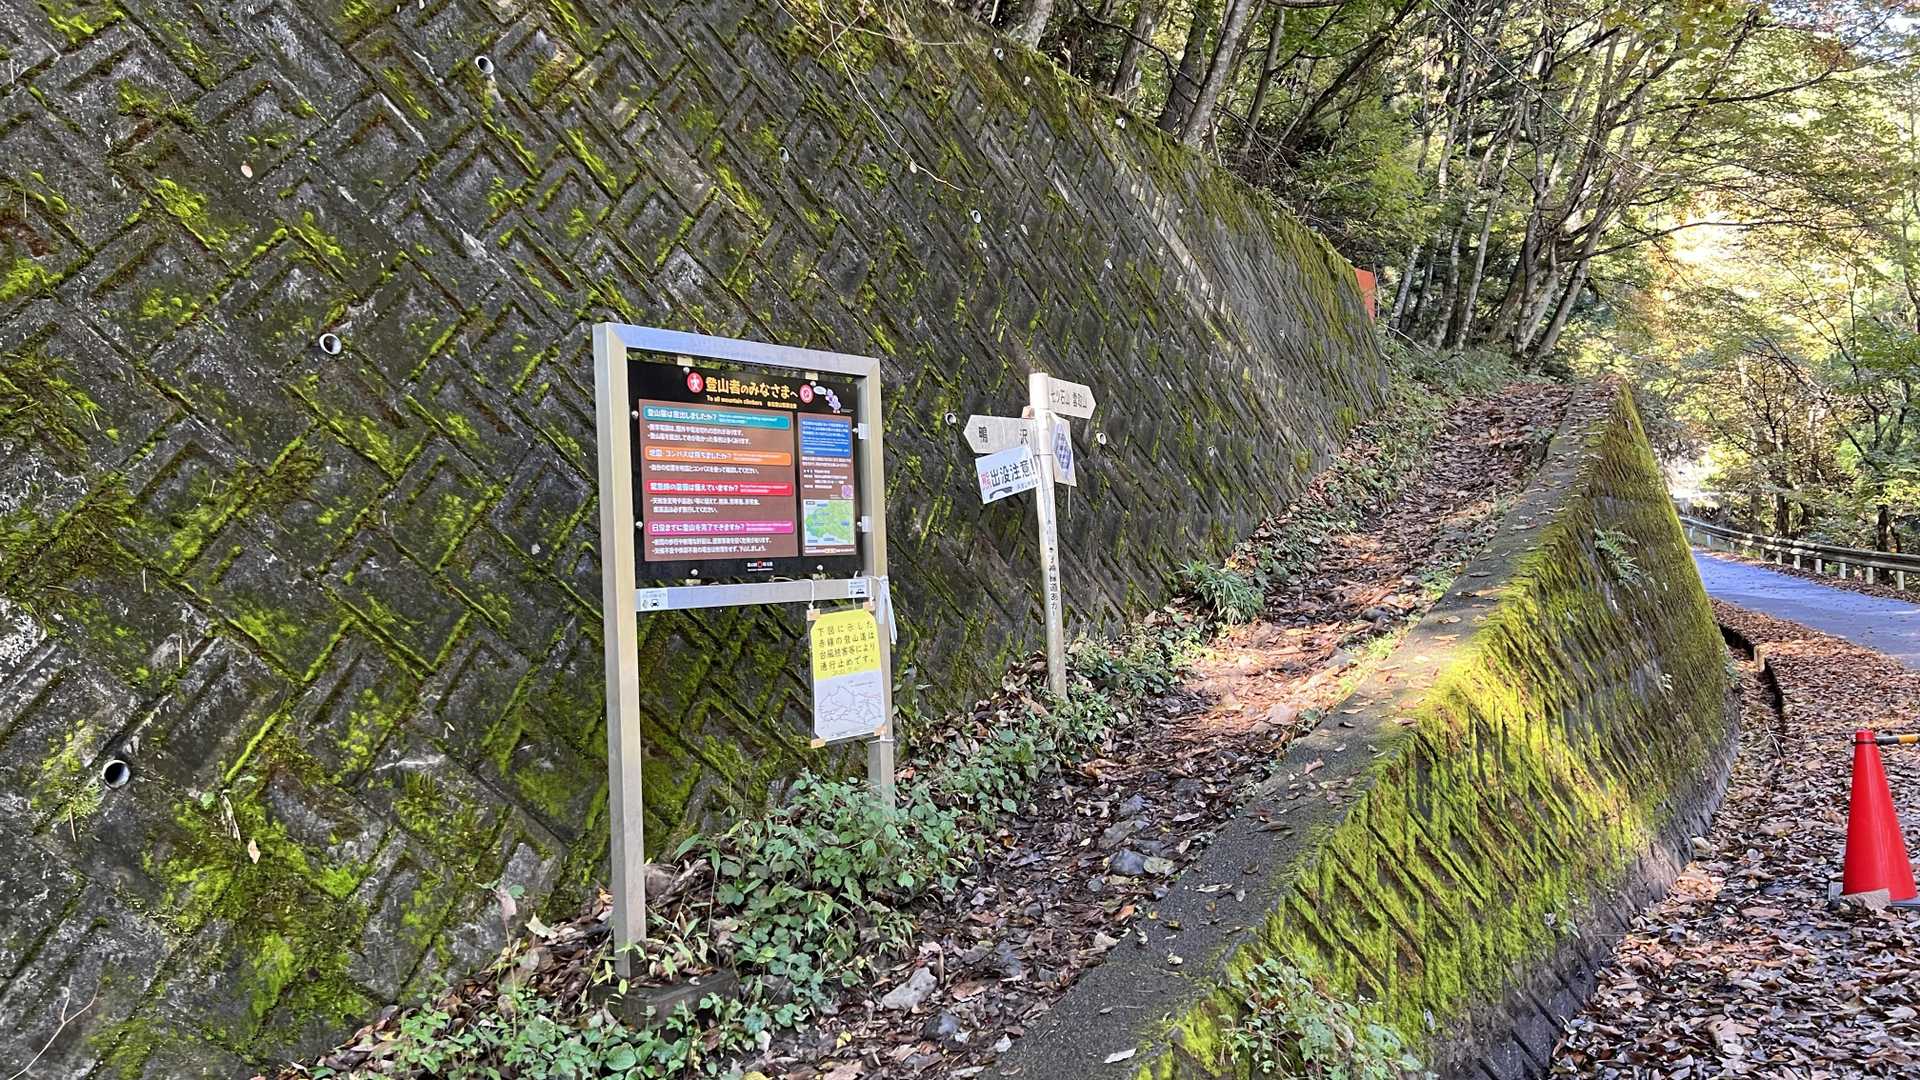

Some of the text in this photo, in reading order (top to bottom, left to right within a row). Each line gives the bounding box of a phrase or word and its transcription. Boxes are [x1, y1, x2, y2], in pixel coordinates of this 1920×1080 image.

[705, 377, 798, 399] 登山者のみなさまへ
